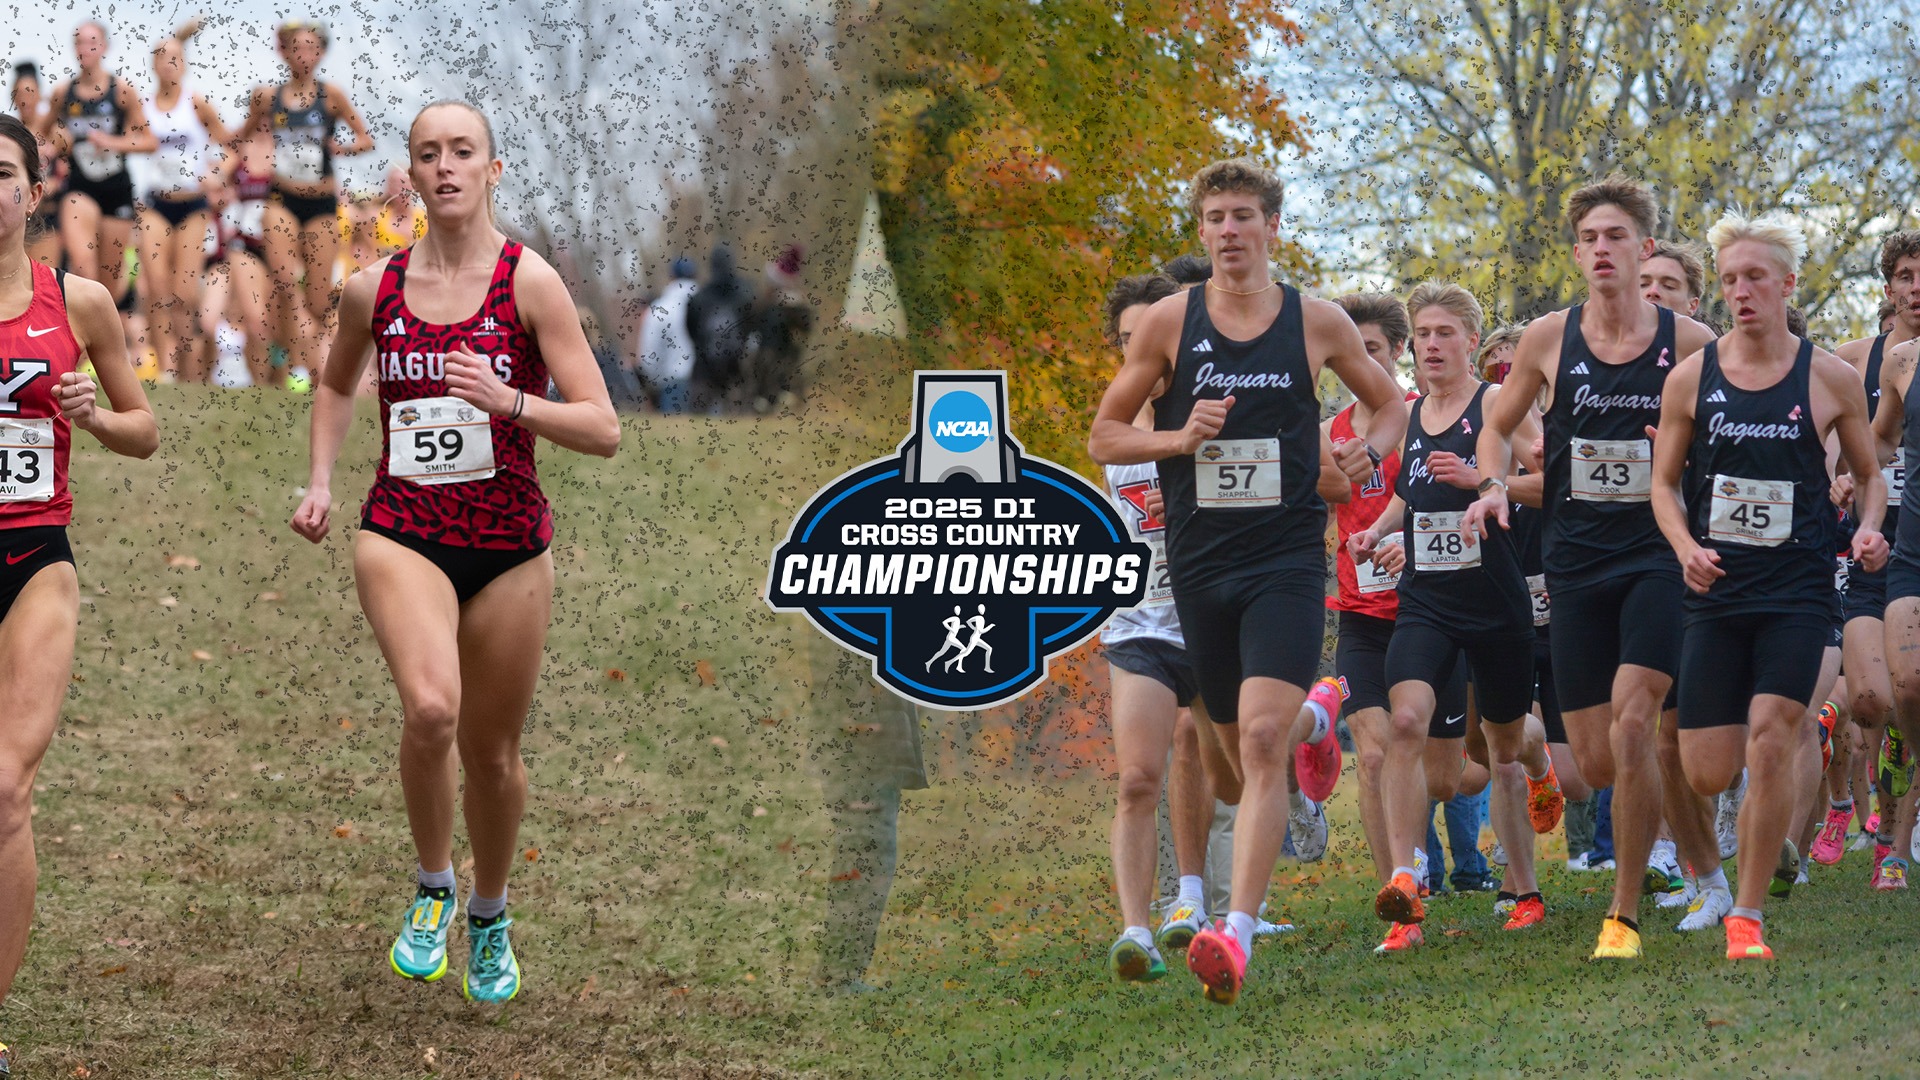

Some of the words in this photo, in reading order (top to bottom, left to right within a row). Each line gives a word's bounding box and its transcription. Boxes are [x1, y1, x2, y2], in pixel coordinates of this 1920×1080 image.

[380, 351, 512, 383] JAGUS
[1192, 362, 1293, 397] Jaguars
[1572, 384, 1662, 416] Jaguars
[1708, 411, 1801, 445] Jaguars
[414, 429, 464, 463] 59
[0, 450, 40, 484] 43
[425, 463, 456, 473] SMITH
[1218, 465, 1258, 490] 57
[1590, 463, 1630, 486] 43
[1217, 490, 1259, 498] SHAPPELL
[1730, 503, 1771, 529] 45
[1427, 533, 1463, 555] 48
[1735, 527, 1764, 537] GRIMES
